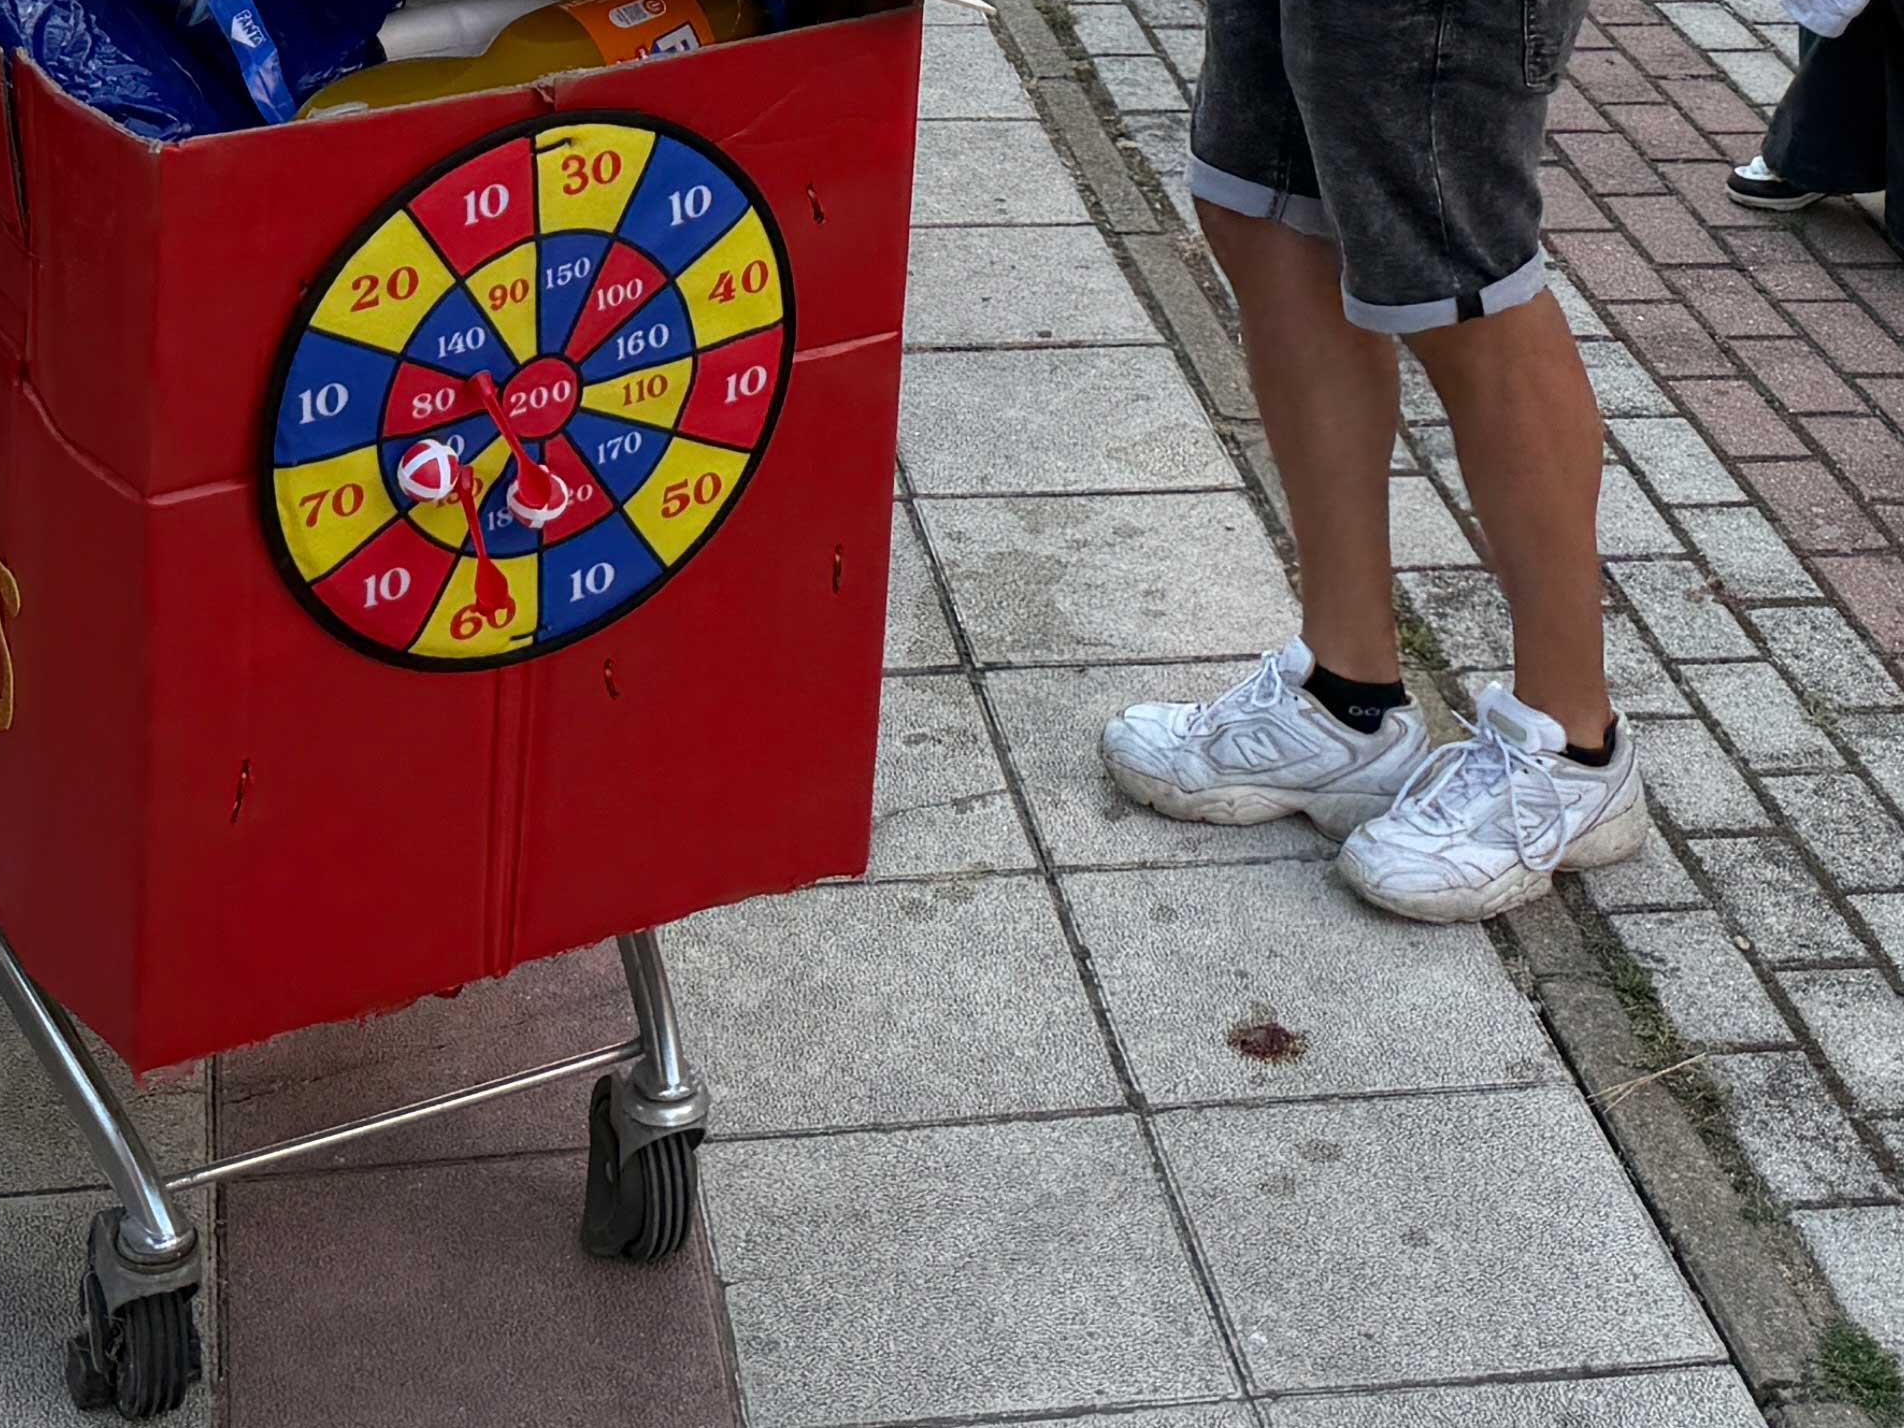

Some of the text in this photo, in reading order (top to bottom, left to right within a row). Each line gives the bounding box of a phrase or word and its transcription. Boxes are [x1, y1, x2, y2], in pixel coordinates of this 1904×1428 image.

[561, 149, 621, 195] 30
[462, 183, 509, 226] 10
[668, 184, 713, 226] 10
[350, 266, 419, 312] 20
[545, 256, 591, 289] 150
[708, 259, 769, 304] 40
[488, 278, 530, 310] 90
[596, 278, 643, 311] 100
[437, 326, 485, 357] 140
[616, 323, 669, 360] 160
[299, 382, 348, 424] 10
[411, 387, 455, 419] 80
[510, 380, 572, 417] 200
[621, 374, 668, 406] 110
[724, 365, 767, 403] 10
[597, 432, 643, 464] 170
[299, 482, 365, 528] 70
[661, 472, 723, 519] 50
[487, 507, 514, 531] 18
[363, 567, 411, 607] 10
[569, 562, 616, 602] 10
[450, 596, 516, 640] 60
